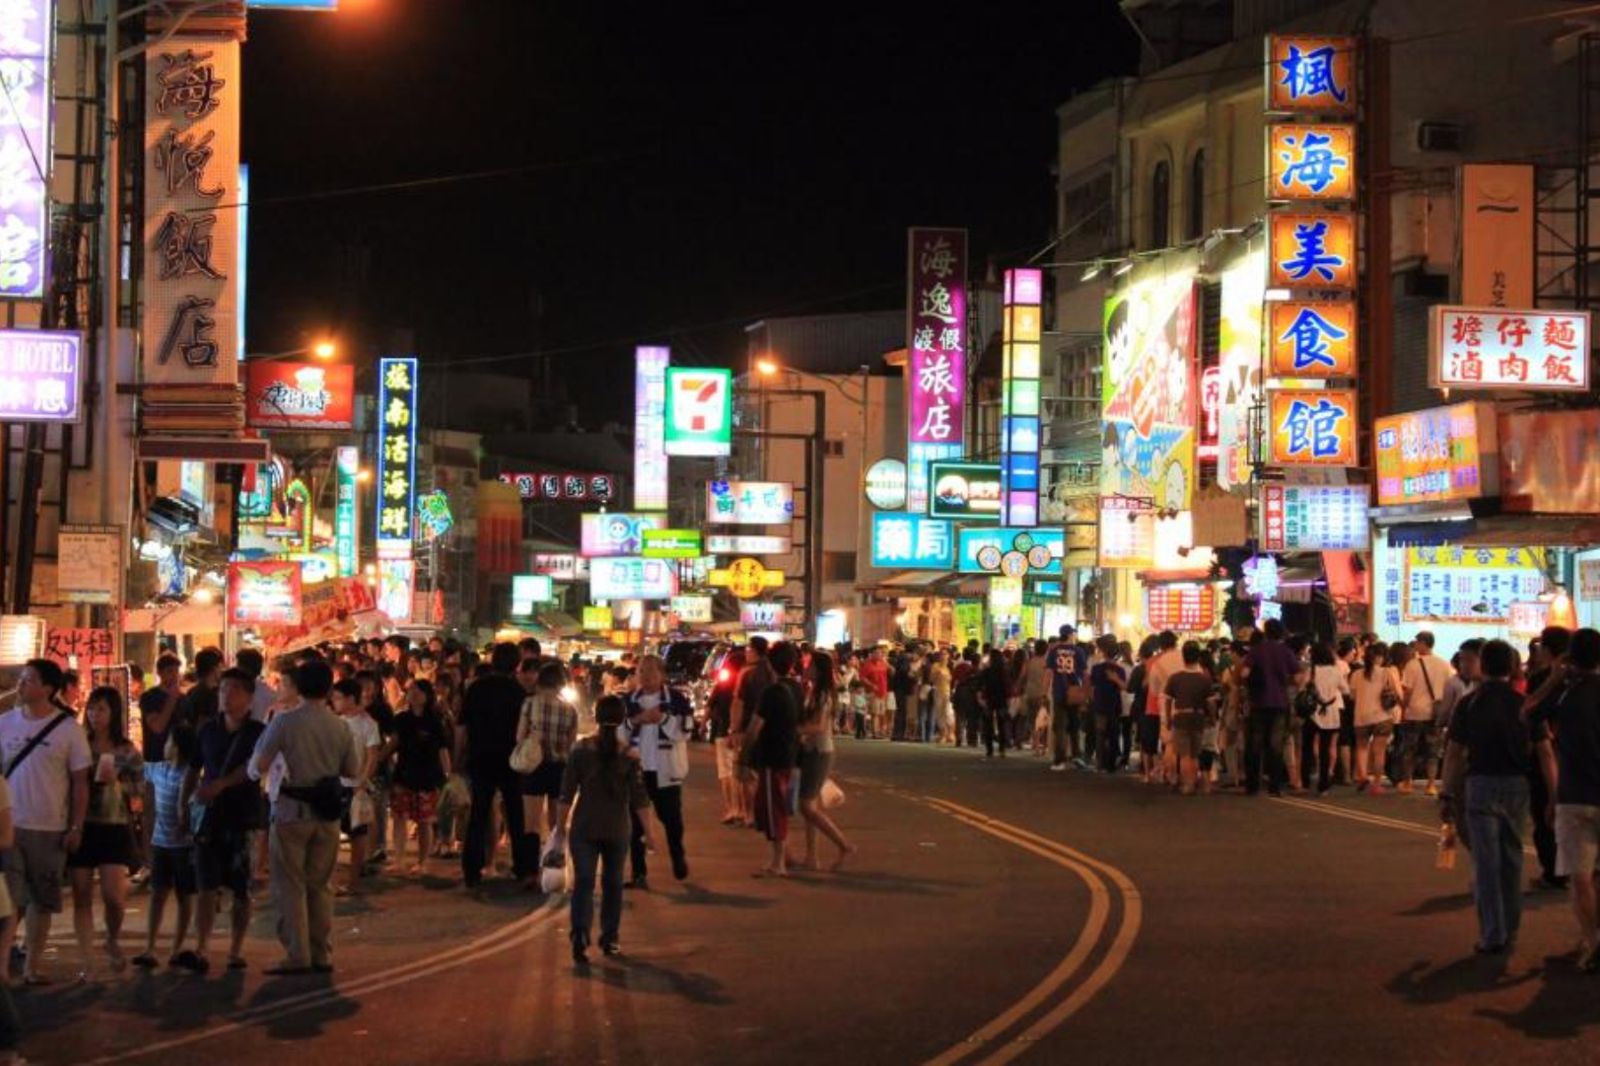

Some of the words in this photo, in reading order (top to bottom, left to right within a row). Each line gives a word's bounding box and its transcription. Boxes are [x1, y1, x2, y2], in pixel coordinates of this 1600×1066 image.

[1280, 45, 1347, 458] 楓海美食館
[877, 519, 948, 560] 藥局
